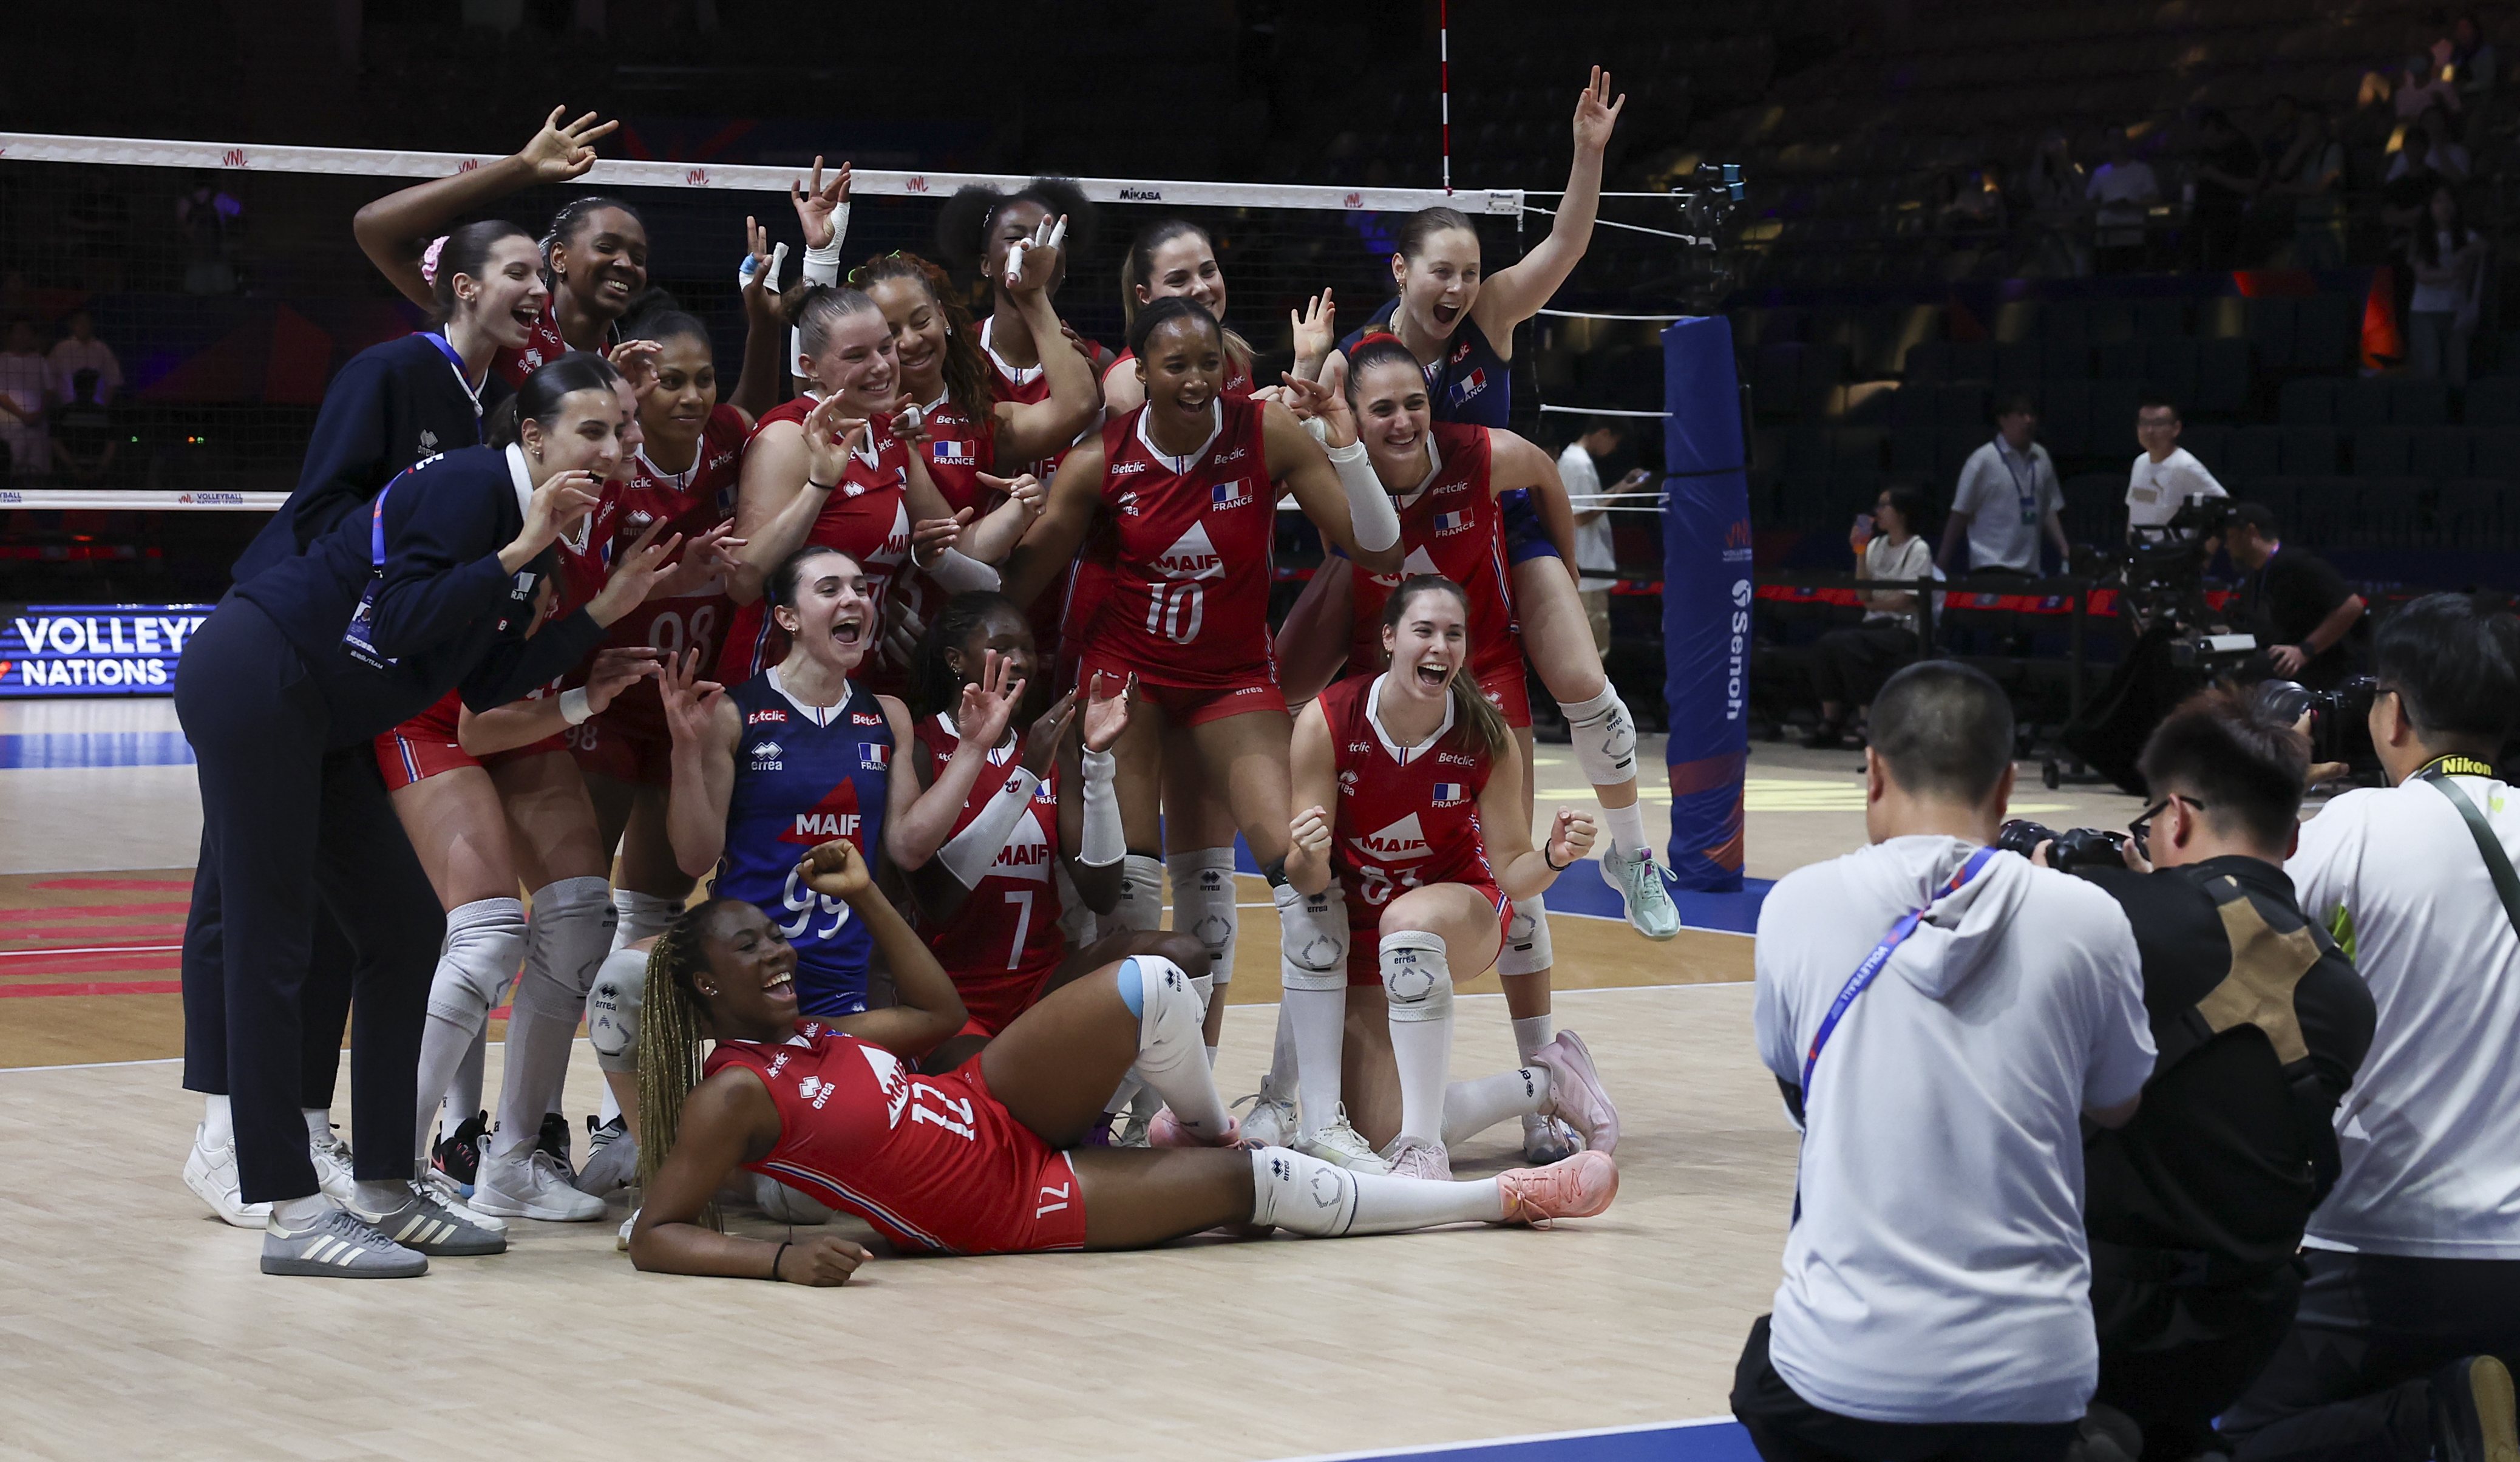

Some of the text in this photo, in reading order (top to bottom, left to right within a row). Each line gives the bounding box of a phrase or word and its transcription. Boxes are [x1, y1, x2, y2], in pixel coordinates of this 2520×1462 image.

[223, 148, 248, 166] VNL
[687, 168, 710, 185] VNL
[906, 175, 929, 192] VNL
[933, 457, 975, 466] FRANCE
[1214, 447, 1246, 465] Beclic
[1111, 461, 1146, 475] Betclic
[1213, 494, 1254, 512] FRANCE
[1435, 520, 1475, 538] FRANCE
[1158, 554, 1220, 573] MAIF
[1146, 583, 1203, 644] 10
[21, 659, 167, 686] NATIONS
[1727, 612, 1750, 721] Senoh
[1607, 716, 1623, 732] errea
[750, 760, 783, 770] errea
[1438, 752, 1475, 766] Betclic
[2442, 757, 2492, 777] Nikon
[795, 814, 861, 836] MAIF
[1362, 837, 1426, 852] MAIF
[991, 844, 1048, 867] MAIF
[779, 862, 849, 940] 99
[1005, 890, 1033, 970] 7
[1394, 955, 1416, 965] errea
[596, 1000, 617, 1011] errea
[812, 1082, 836, 1110] errea
[911, 1081, 975, 1141] 12
[1036, 1182, 1070, 1220] 12
